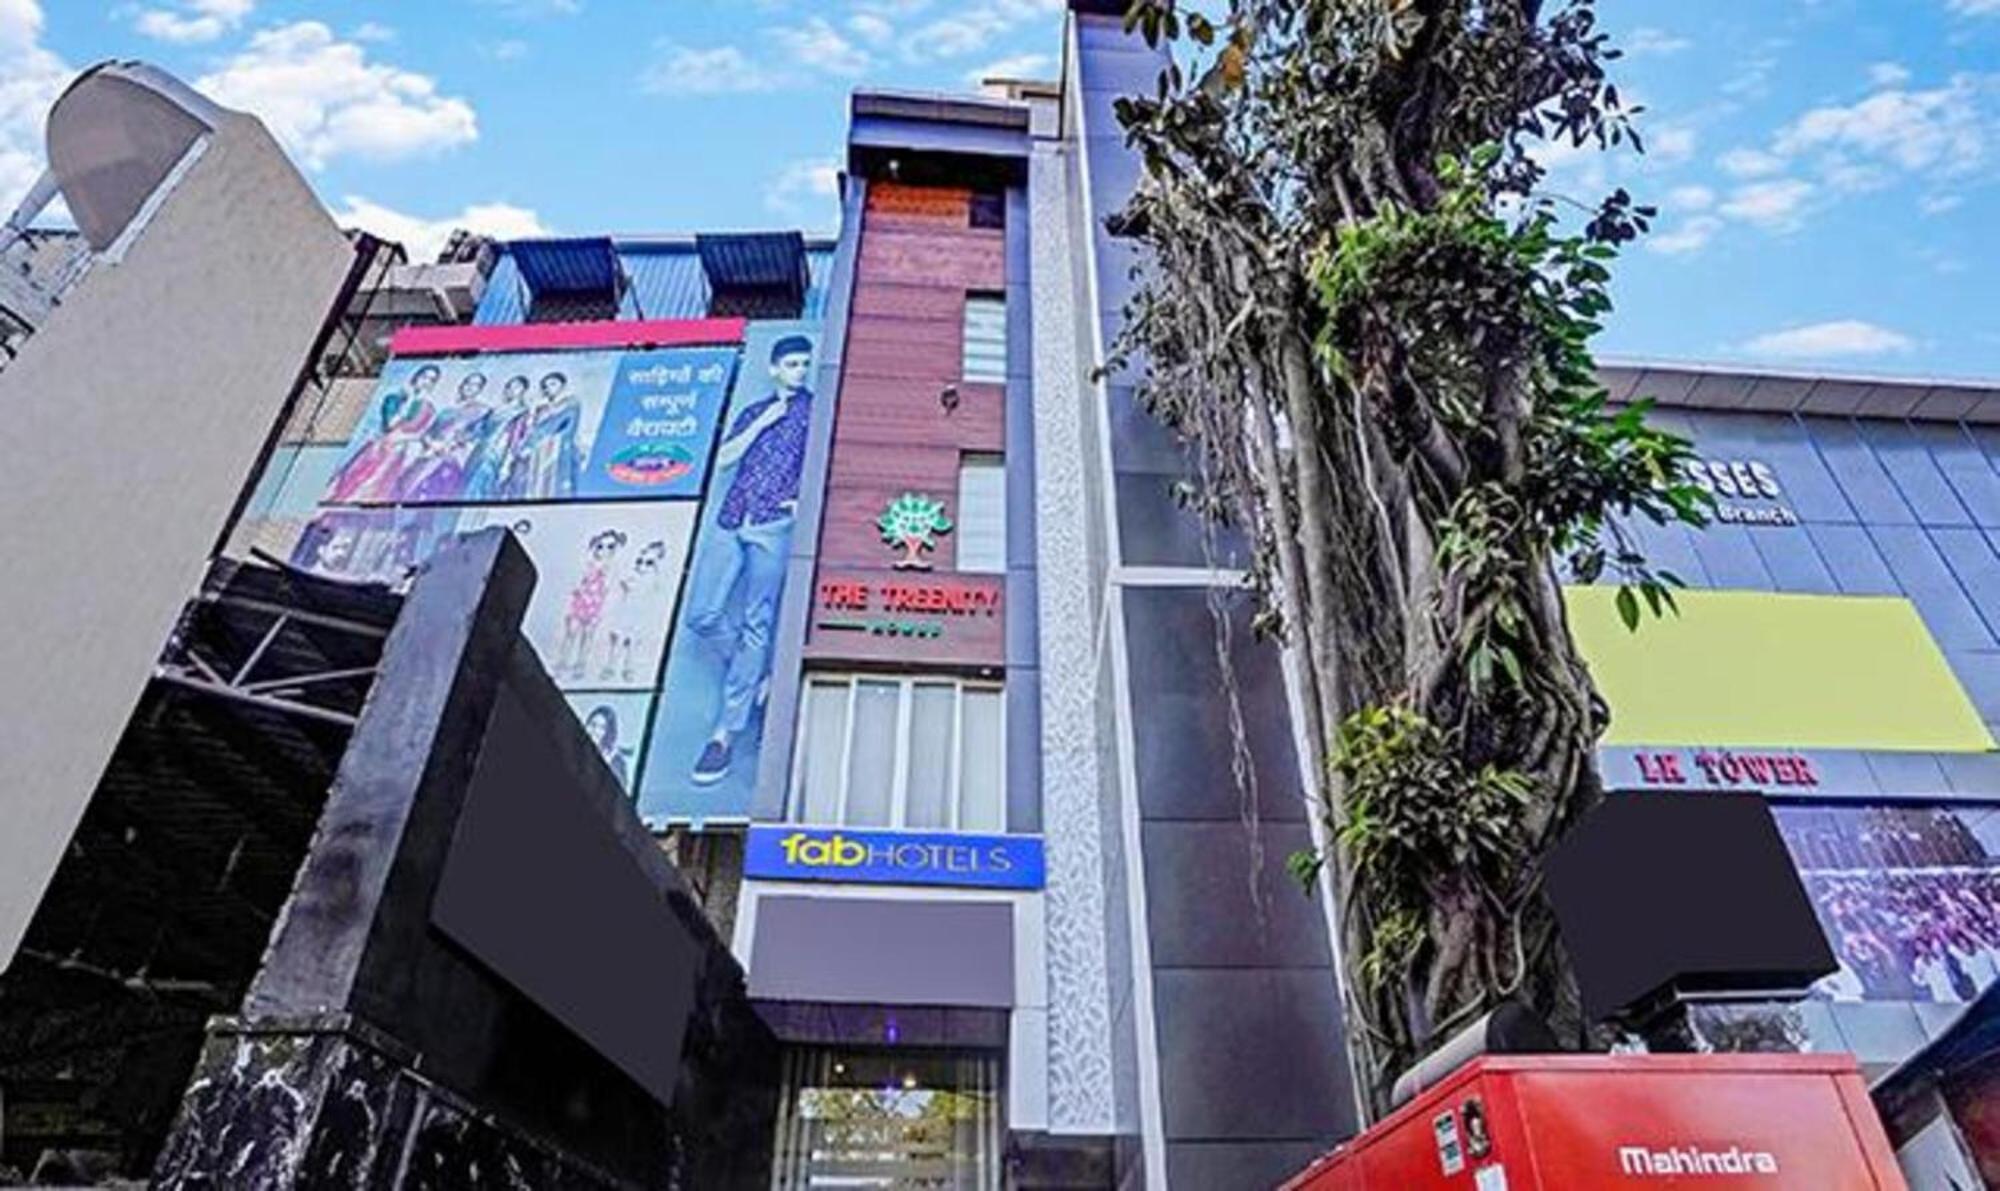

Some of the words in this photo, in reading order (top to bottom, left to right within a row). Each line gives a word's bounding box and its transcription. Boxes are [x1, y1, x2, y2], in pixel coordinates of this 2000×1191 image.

[821, 581, 868, 609] THE
[880, 582, 999, 616] TREENITY
[1634, 752, 1686, 784] LK
[1695, 750, 1819, 786] TOWER
[1618, 1146, 1778, 1174] Mahindra
